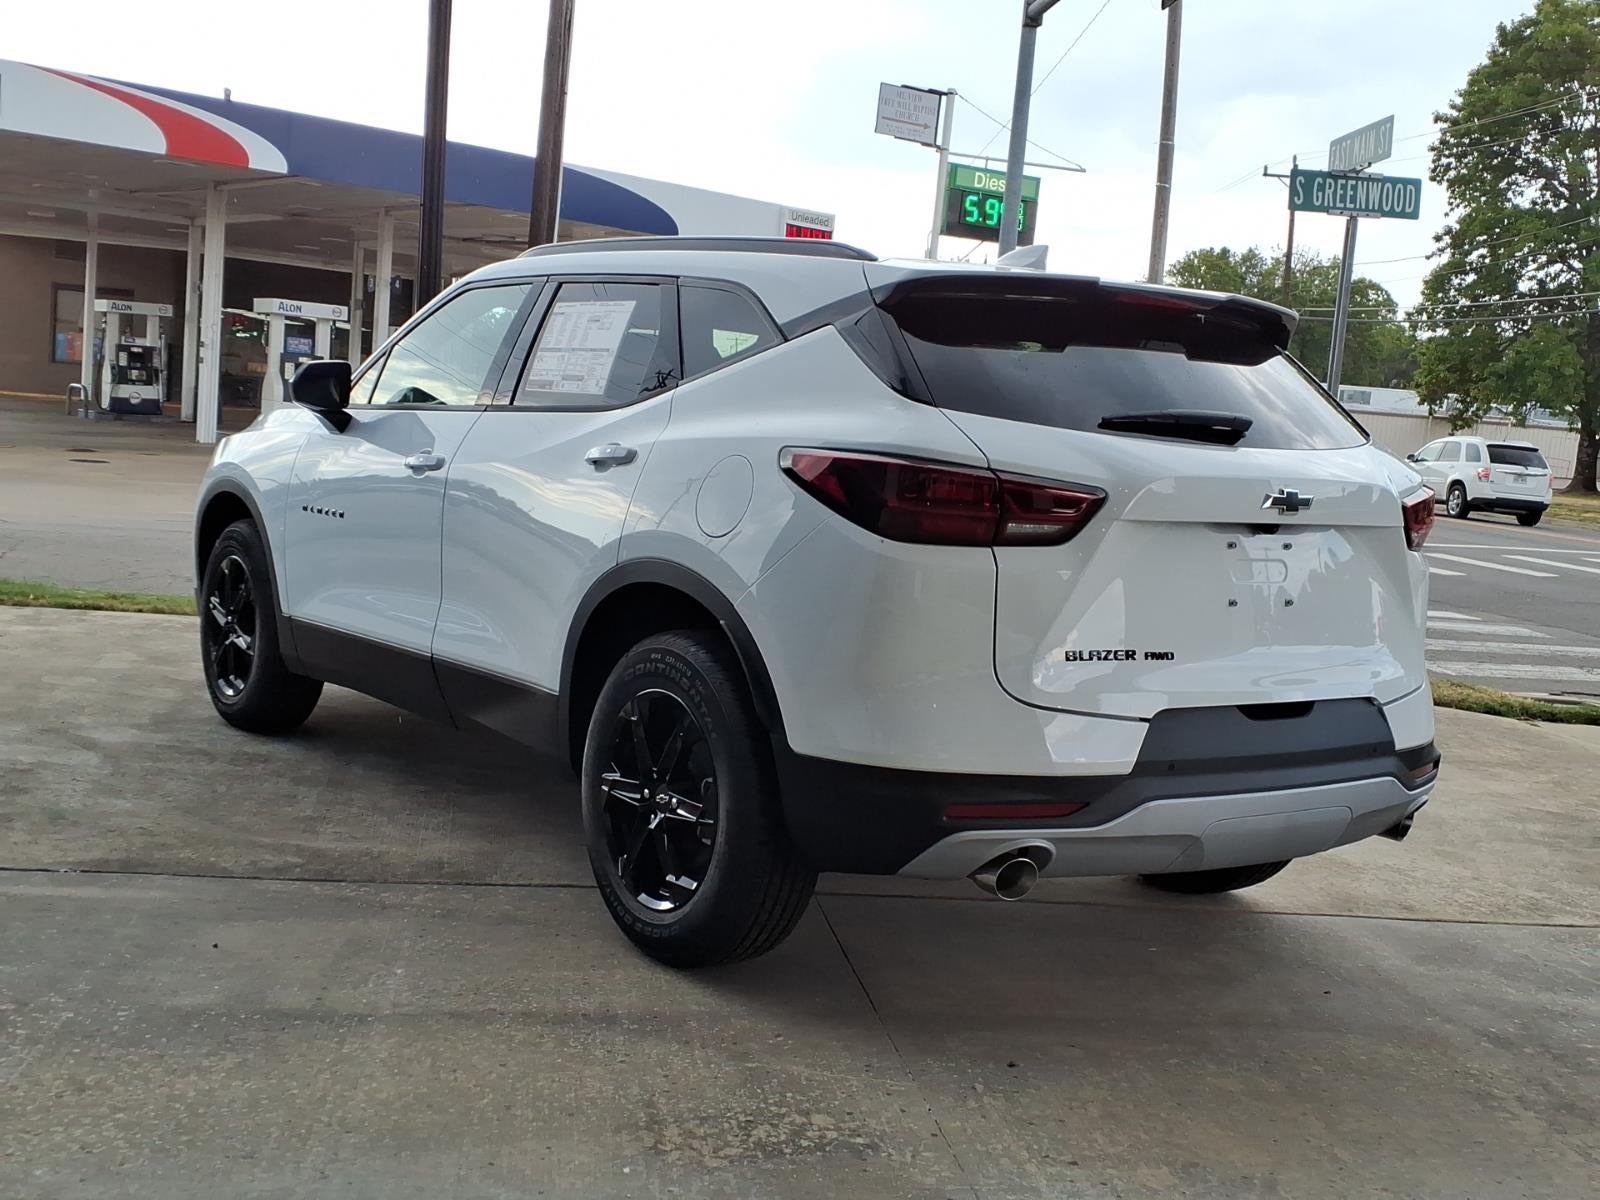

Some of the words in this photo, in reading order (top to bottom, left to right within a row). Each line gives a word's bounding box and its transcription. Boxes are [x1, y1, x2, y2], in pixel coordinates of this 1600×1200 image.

[1329, 141, 1350, 170] EAST
[1354, 130, 1376, 167] MAIN
[1377, 123, 1392, 154] ST
[974, 171, 1007, 192] Dies
[1294, 176, 1305, 205] S
[1313, 177, 1416, 213] GREENWOOD
[791, 210, 830, 227] Unleaded
[278, 301, 303, 314] ALON
[1065, 649, 1137, 662] BLAZER
[1144, 651, 1175, 661] AWD
